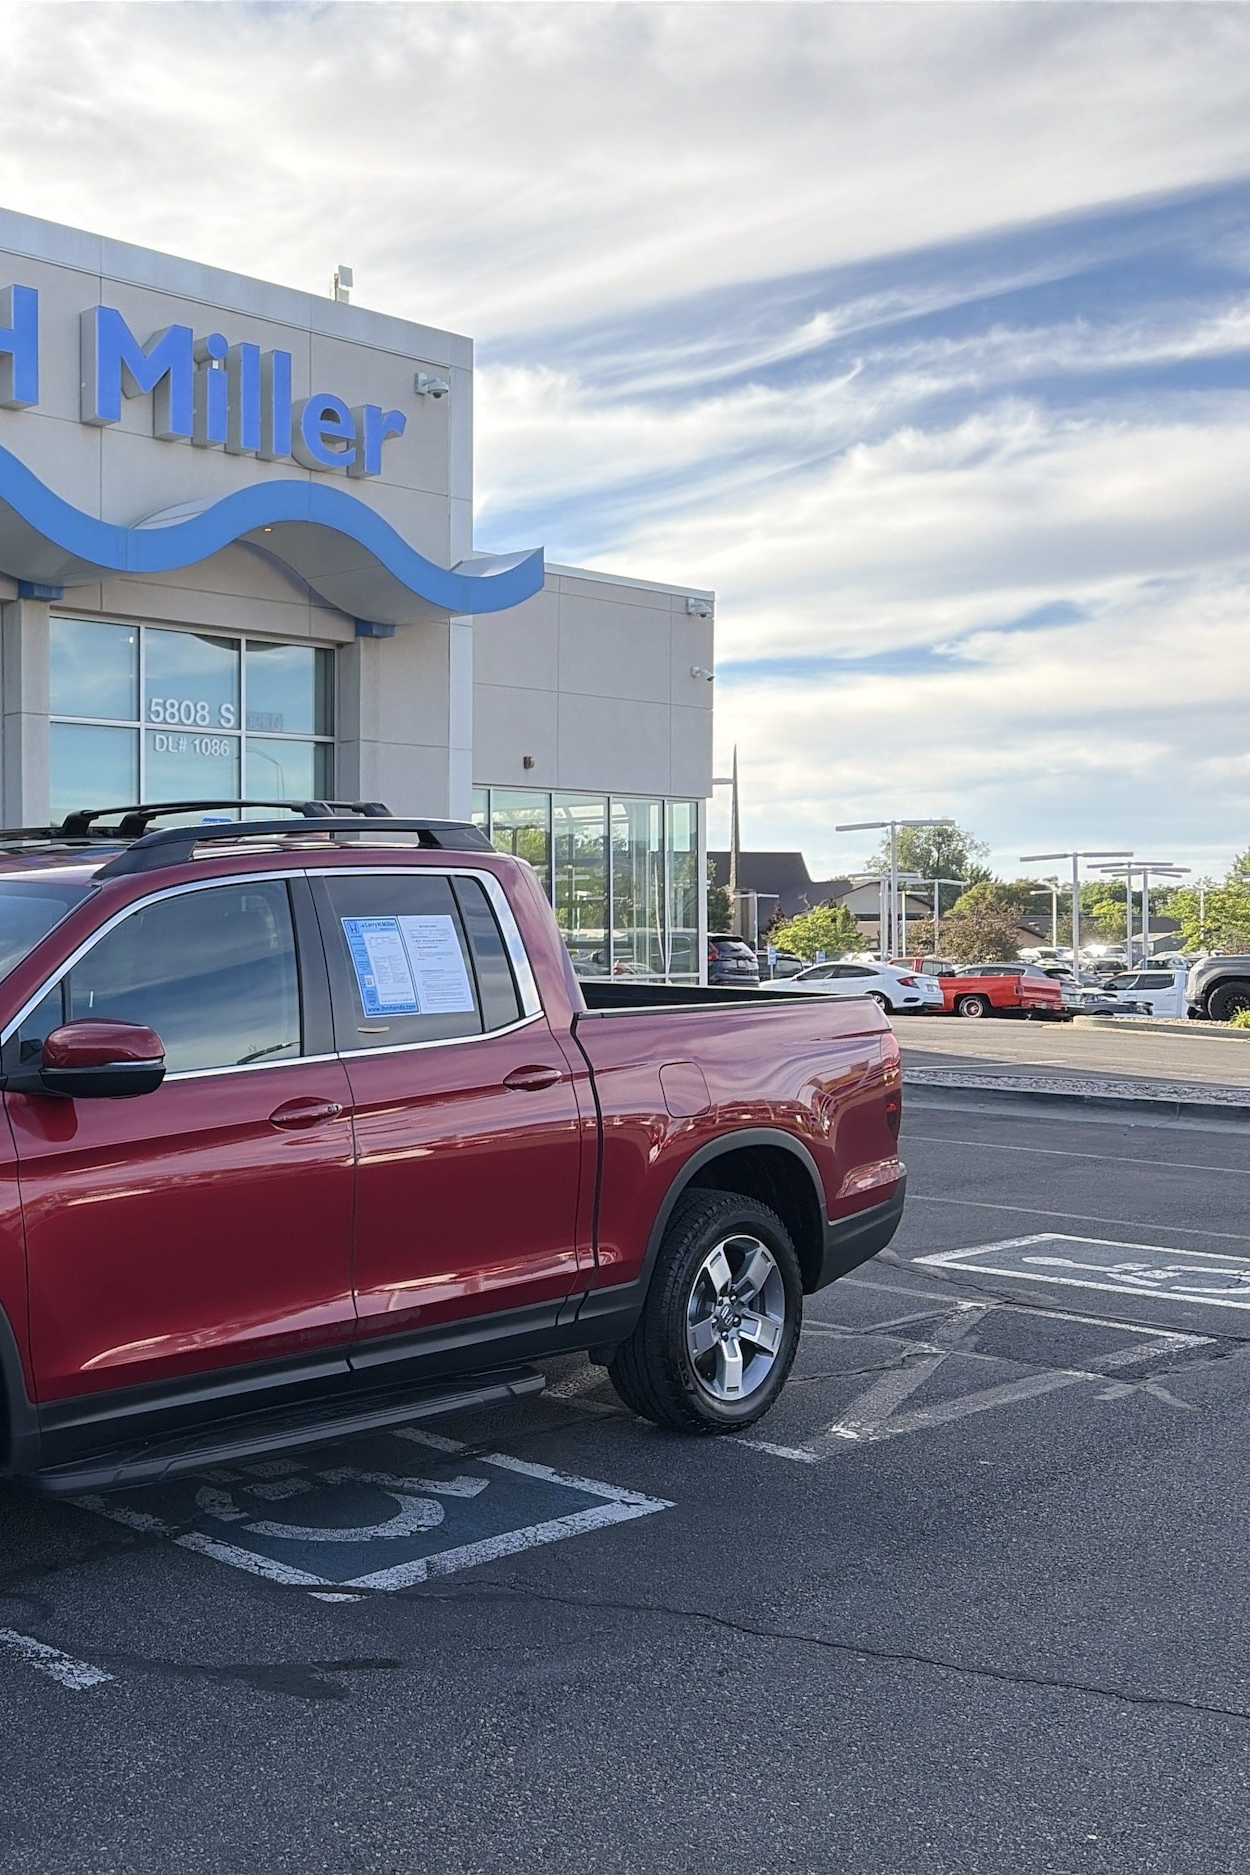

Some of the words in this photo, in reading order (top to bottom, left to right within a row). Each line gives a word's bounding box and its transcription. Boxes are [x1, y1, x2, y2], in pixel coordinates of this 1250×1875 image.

[85, 305, 406, 477] Miller
[150, 698, 210, 726] 5808
[220, 703, 234, 728] S
[155, 735, 187, 752] DL#
[193, 738, 229, 756] 1086
